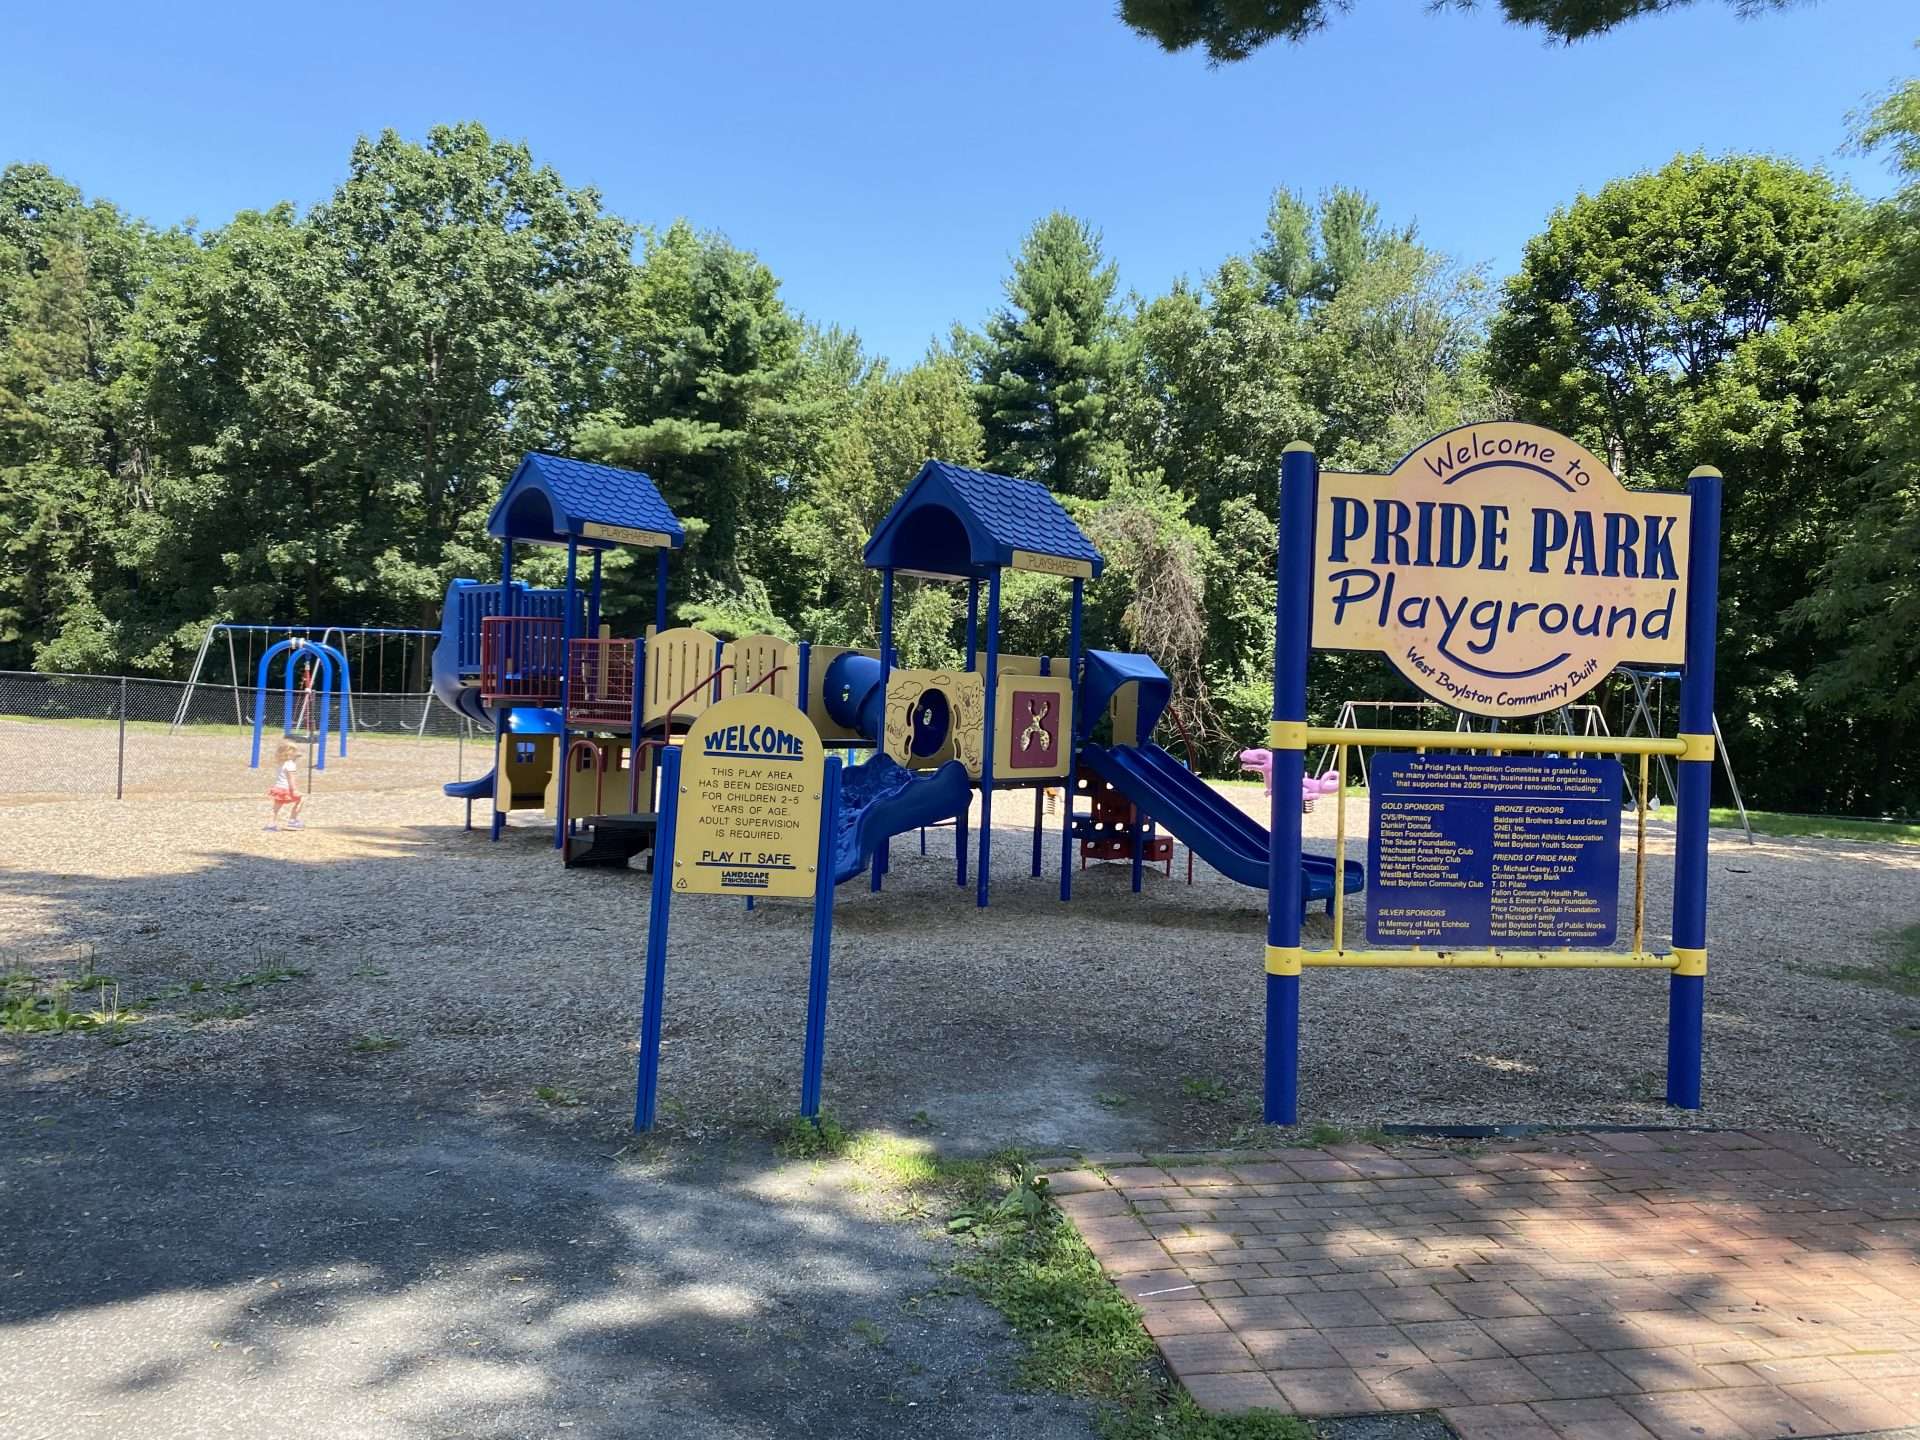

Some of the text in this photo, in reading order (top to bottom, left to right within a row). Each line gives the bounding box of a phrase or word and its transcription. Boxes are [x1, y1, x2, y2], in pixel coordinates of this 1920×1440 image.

[1424, 432, 1590, 486] Welcome to
[1328, 497, 1679, 581] PRIDE PARK
[1328, 569, 1676, 654] Playground
[1407, 646, 1598, 706] West Boylston Community Built
[704, 725, 804, 754] WELCOME
[712, 768, 793, 780] THIS PLAY AREA
[1552, 767, 1578, 775] grateful
[1406, 772, 1425, 780] many
[699, 780, 804, 792] HAS BEEN DESIGNED
[1412, 781, 1448, 789] supported
[1483, 783, 1523, 792] playground
[702, 792, 799, 804] FOR CHILDREN 2-5
[712, 805, 743, 814] YEARS
[768, 808, 790, 816] AGE.
[1404, 803, 1445, 811] SPONSORS
[1525, 806, 1564, 814] SPONSORS
[699, 817, 800, 828] ADULT SUPERVISION
[1512, 833, 1540, 841] Boylston
[1435, 848, 1456, 856] Rotary
[702, 851, 791, 865] PLAY IT SAFE
[1417, 856, 1444, 864] Country
[722, 871, 769, 879] LANDSCAPE
[1398, 880, 1427, 888] Boylston
[1429, 880, 1466, 888] Community
[1387, 921, 1413, 929] Memory
[1397, 929, 1425, 937] Boylston
[1509, 930, 1536, 938] Boylston
